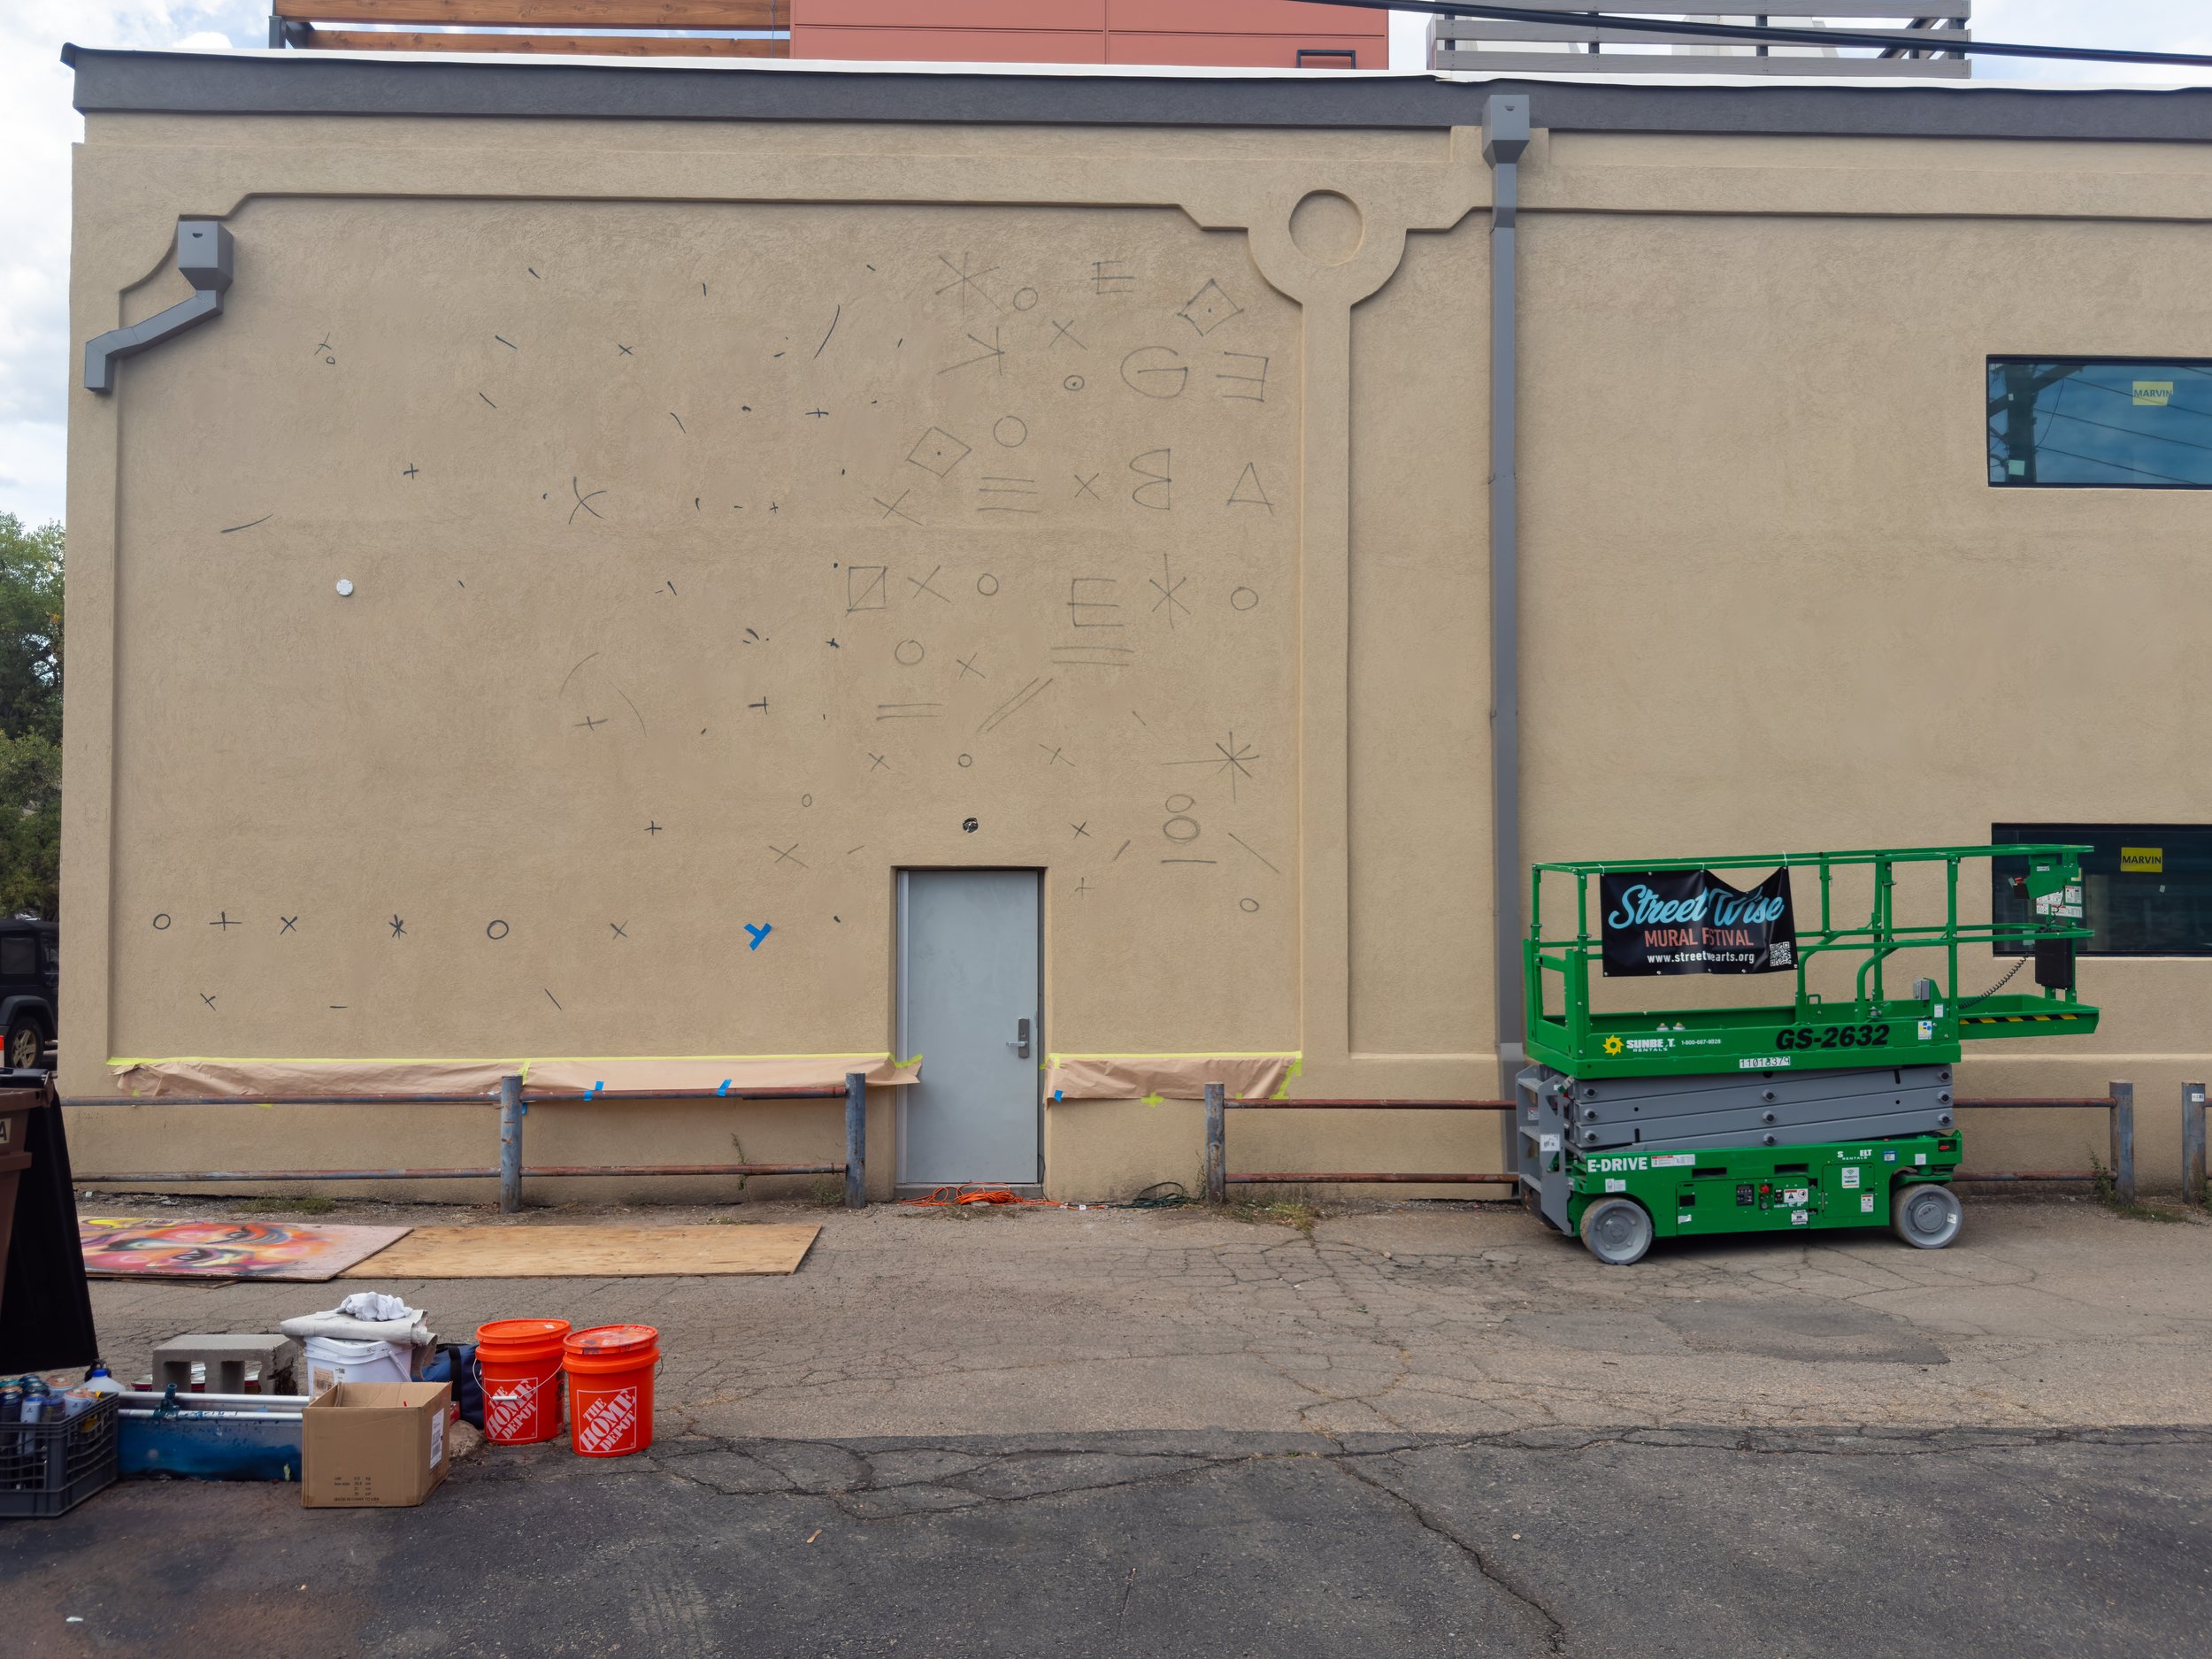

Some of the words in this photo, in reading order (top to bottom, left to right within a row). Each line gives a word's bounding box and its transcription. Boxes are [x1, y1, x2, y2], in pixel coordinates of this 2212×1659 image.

[1608, 884, 1709, 929] Street
[1709, 887, 1785, 926] Wise
[1644, 929, 1698, 948] MURAL
[1702, 927, 1755, 947] FSTIVAL
[1626, 1038, 1676, 1048] SUNBET
[1776, 1024, 1890, 1049] GS-2632
[1587, 1157, 1647, 1172] E-DRIVE
[487, 1379, 537, 1440] HOME
[501, 1401, 537, 1440] DEPOT
[580, 1389, 636, 1451] HOME
[582, 1397, 607, 1422] THE
[599, 1410, 636, 1451] DEPOT
